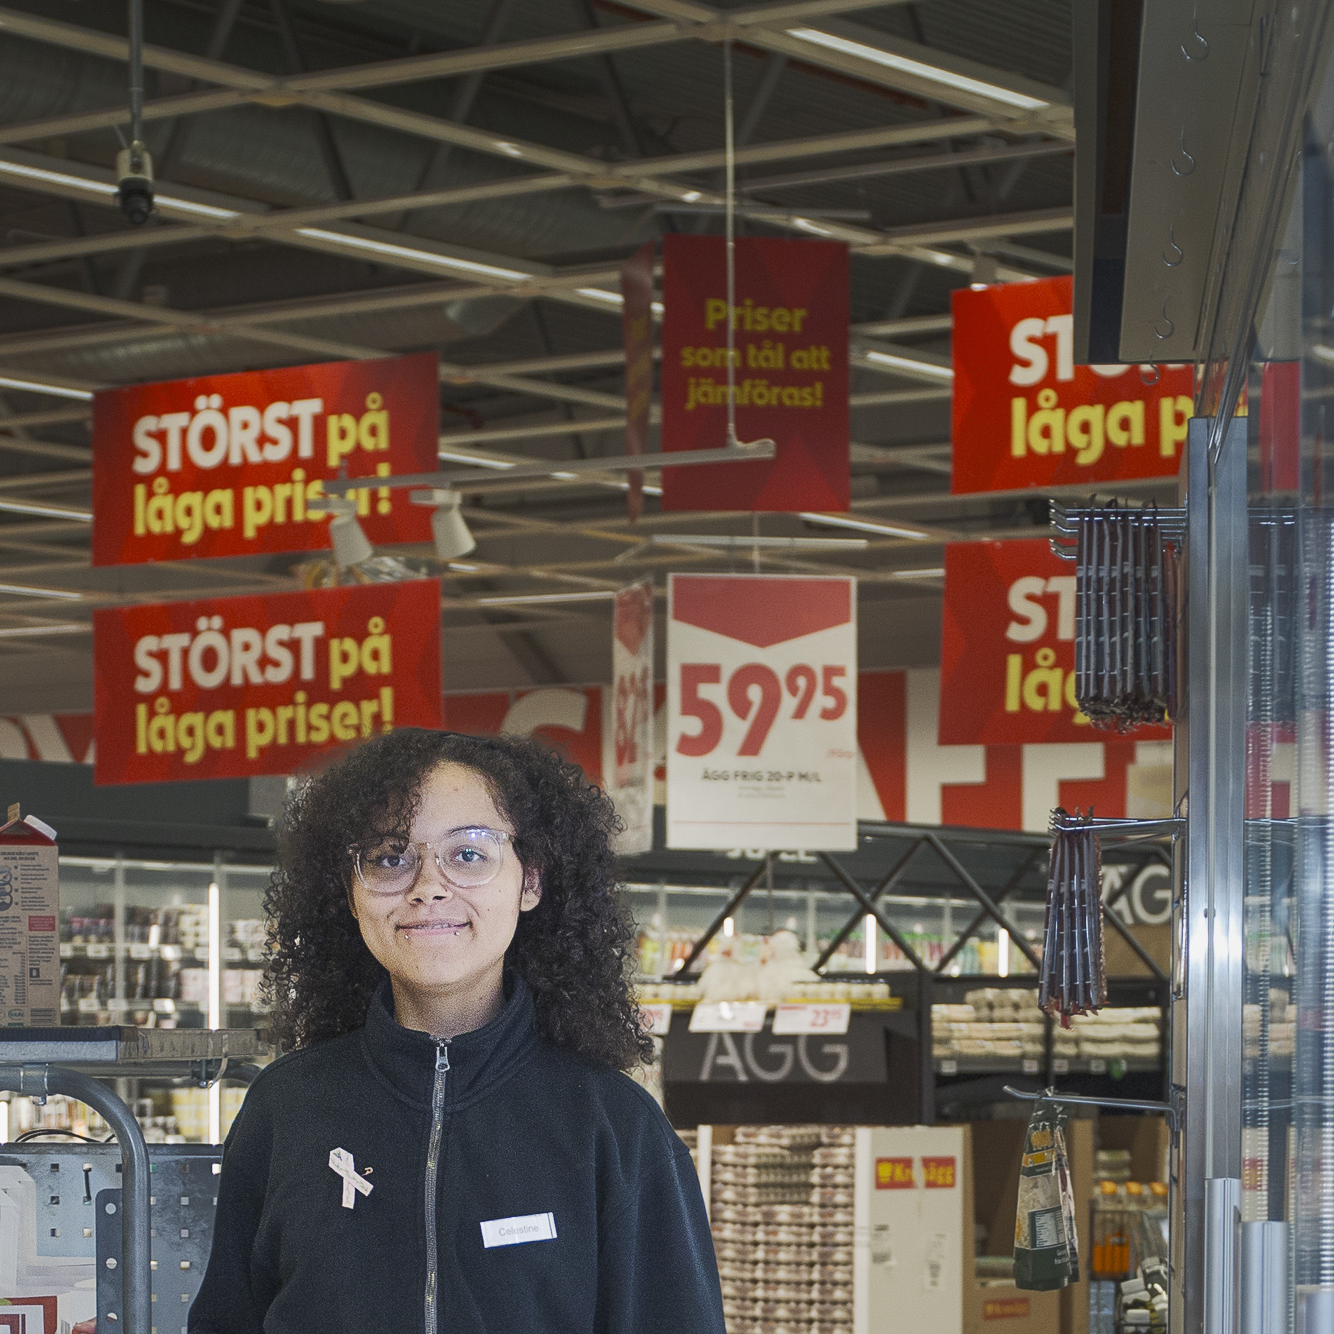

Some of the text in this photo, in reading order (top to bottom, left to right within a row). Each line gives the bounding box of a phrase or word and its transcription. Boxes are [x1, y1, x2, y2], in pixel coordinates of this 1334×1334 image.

[705, 298, 808, 332] Priser
[681, 339, 831, 370] som tål att
[685, 377, 823, 410] jämföras!
[132, 392, 390, 474] STÖRST på
[1011, 388, 1145, 467] låga
[133, 476, 235, 545] låga
[134, 615, 393, 694] STÖRST på
[135, 696, 236, 764] låga
[245, 687, 394, 760] priser!
[893, 1162, 954, 1185] Krägg
[498, 1224, 540, 1237] Celestine
